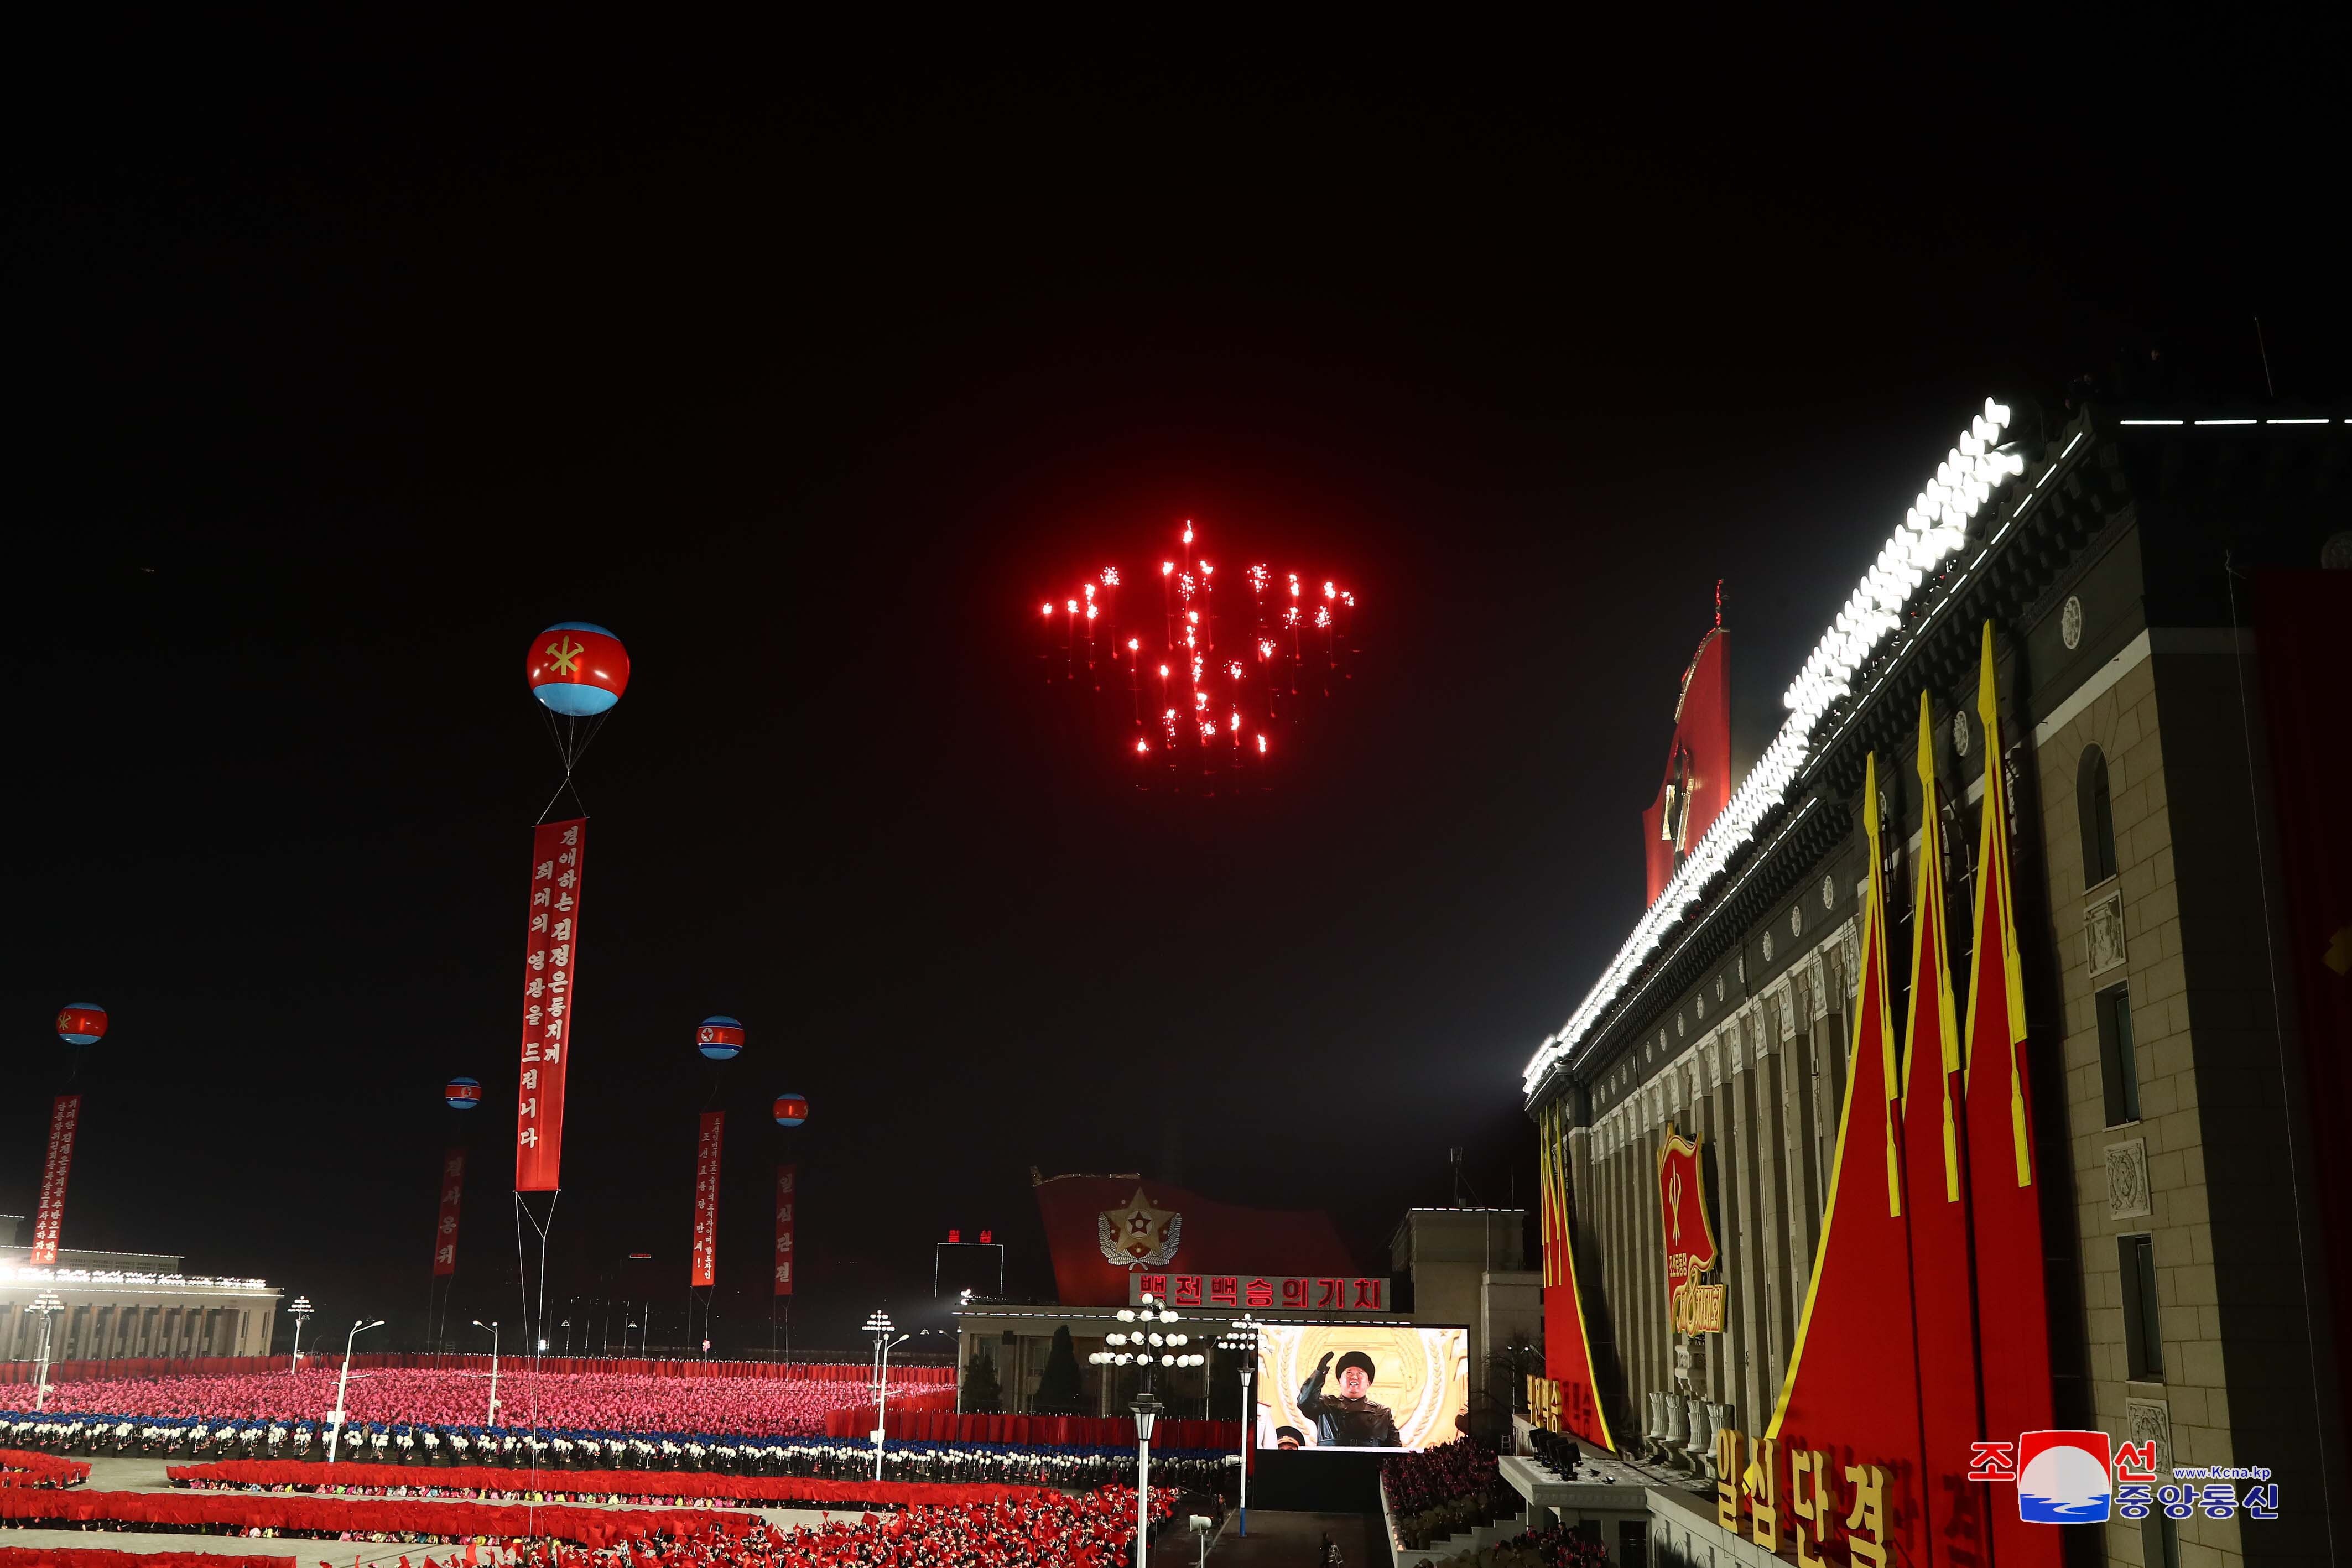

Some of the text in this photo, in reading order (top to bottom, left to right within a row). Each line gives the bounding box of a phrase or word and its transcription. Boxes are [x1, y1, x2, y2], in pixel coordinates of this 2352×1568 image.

[520, 860, 553, 1148] 최대의 영광을 드립니다
[543, 826, 578, 1064] 경애하는 김정은동지께
